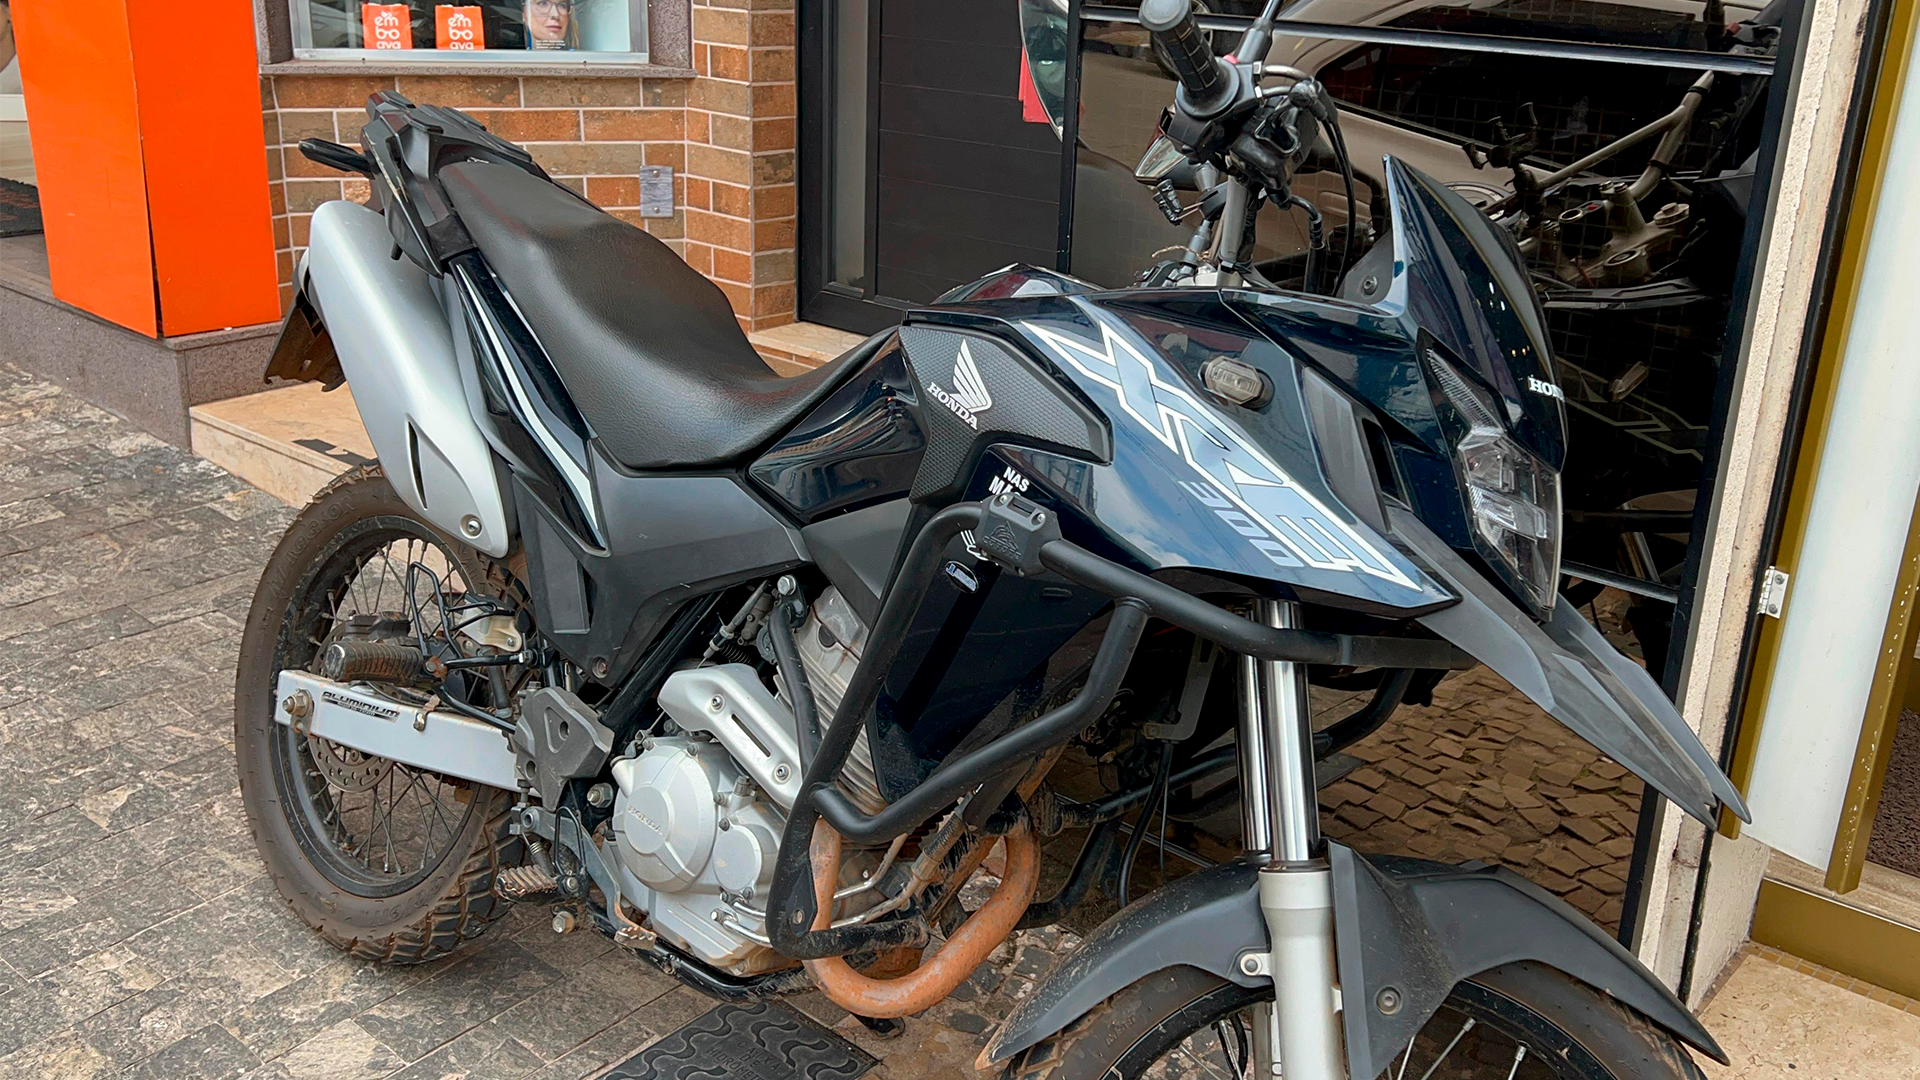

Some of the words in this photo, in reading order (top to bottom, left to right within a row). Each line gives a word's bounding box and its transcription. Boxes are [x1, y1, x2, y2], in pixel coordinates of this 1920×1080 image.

[375, 25, 400, 40] bo
[448, 26, 474, 41] bo
[927, 381, 978, 430] HONDA
[1020, 319, 1423, 593] XRE
[1003, 466, 1030, 492] NAS
[1178, 480, 1305, 568] 300
[322, 690, 400, 718] ALUMINIUM
[737, 1040, 781, 1071] CAIXA
[740, 1053, 761, 1069] DE
